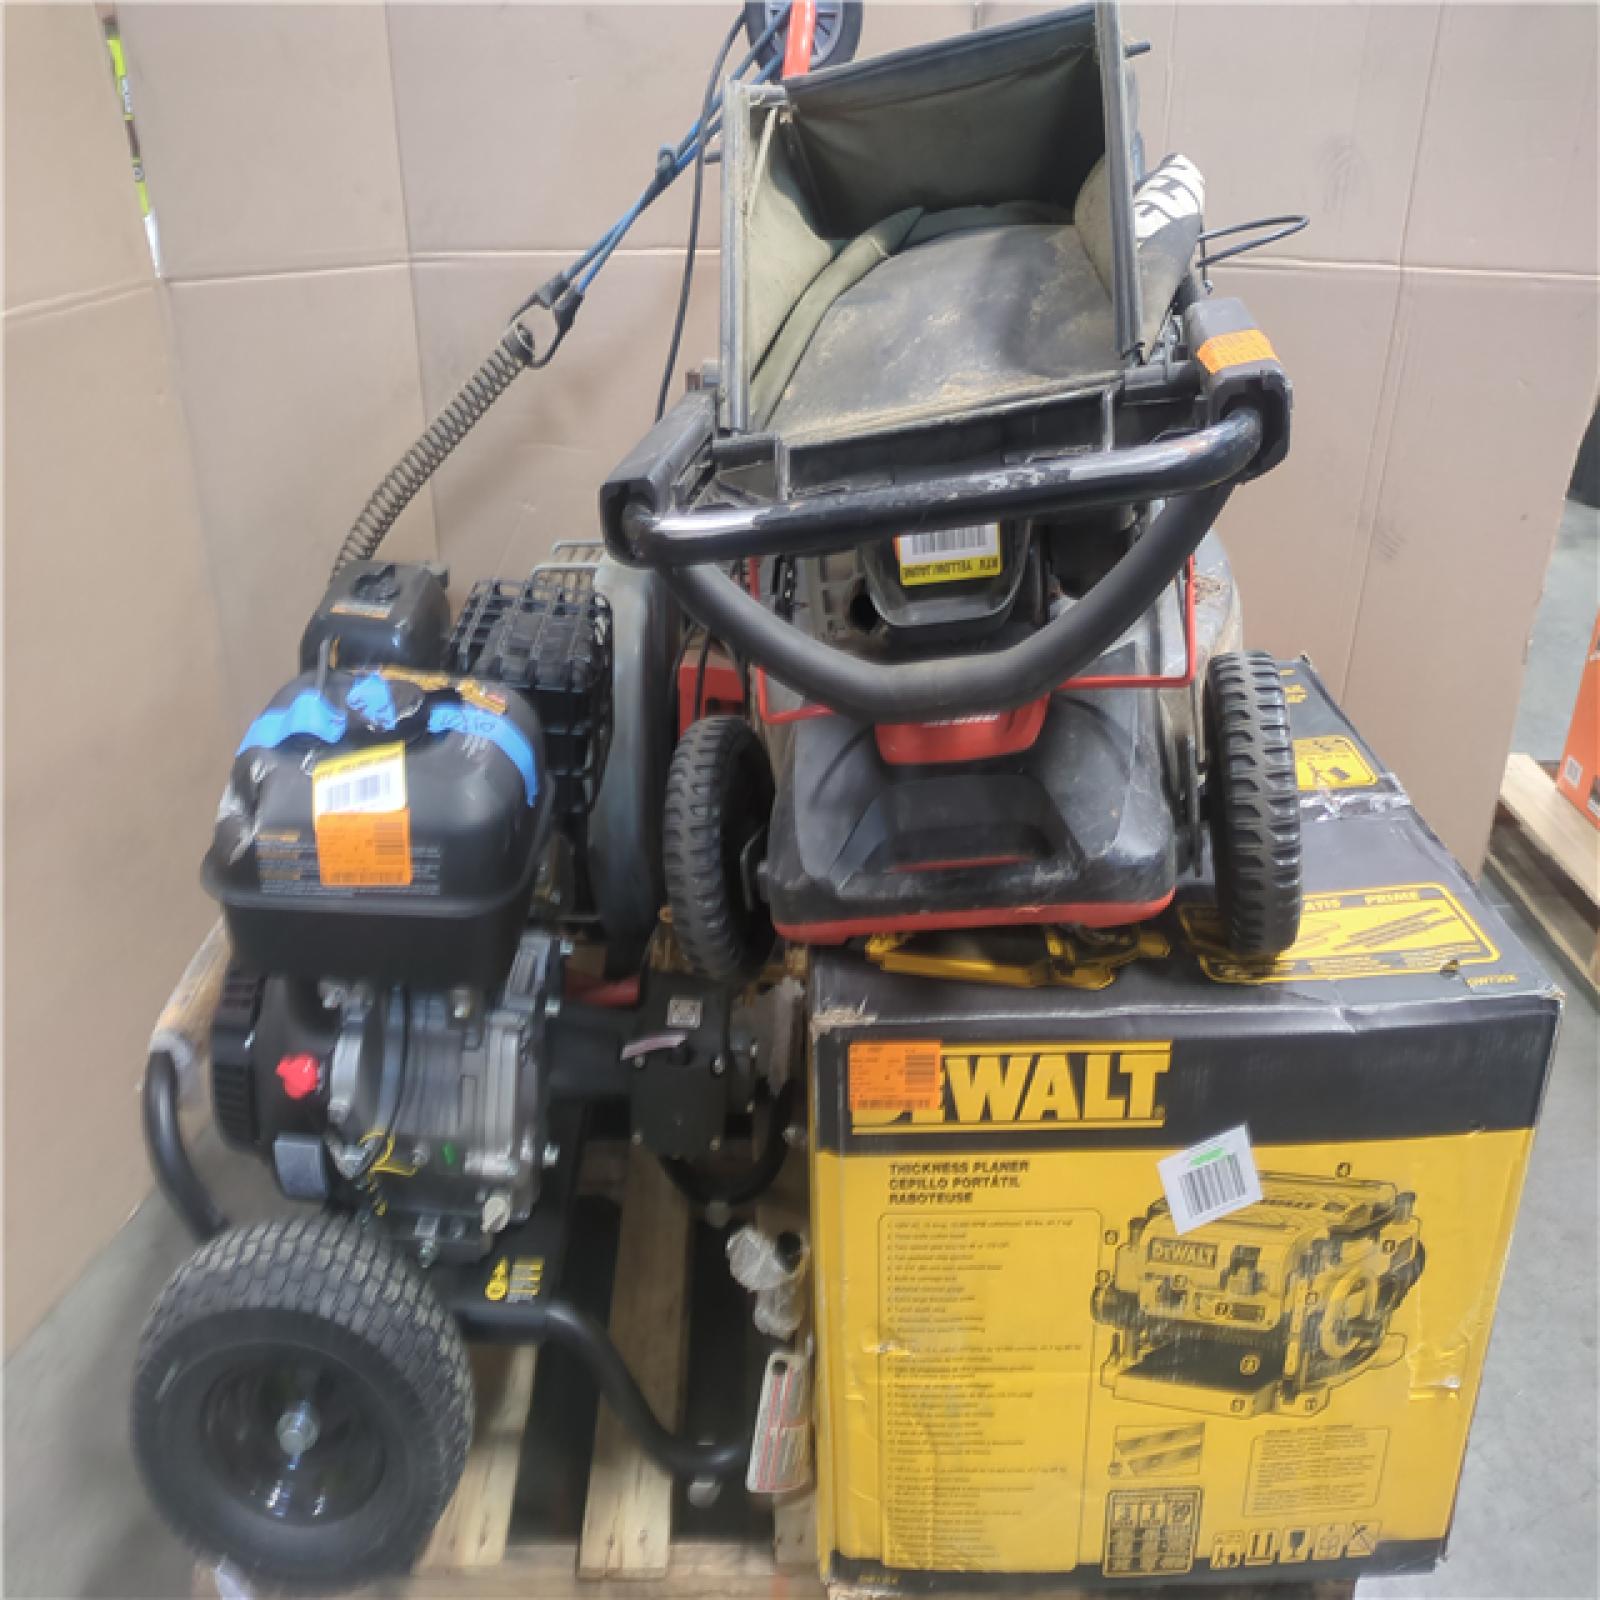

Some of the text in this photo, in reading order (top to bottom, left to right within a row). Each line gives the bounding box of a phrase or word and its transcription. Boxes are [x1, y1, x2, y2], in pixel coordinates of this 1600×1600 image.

[852, 1052, 1170, 1125] WALT
[889, 1159, 1030, 1175] THICKNESS PLANER
[889, 1177, 949, 1190] CEPILLO
[889, 1192, 974, 1204] RABOTEUSE
